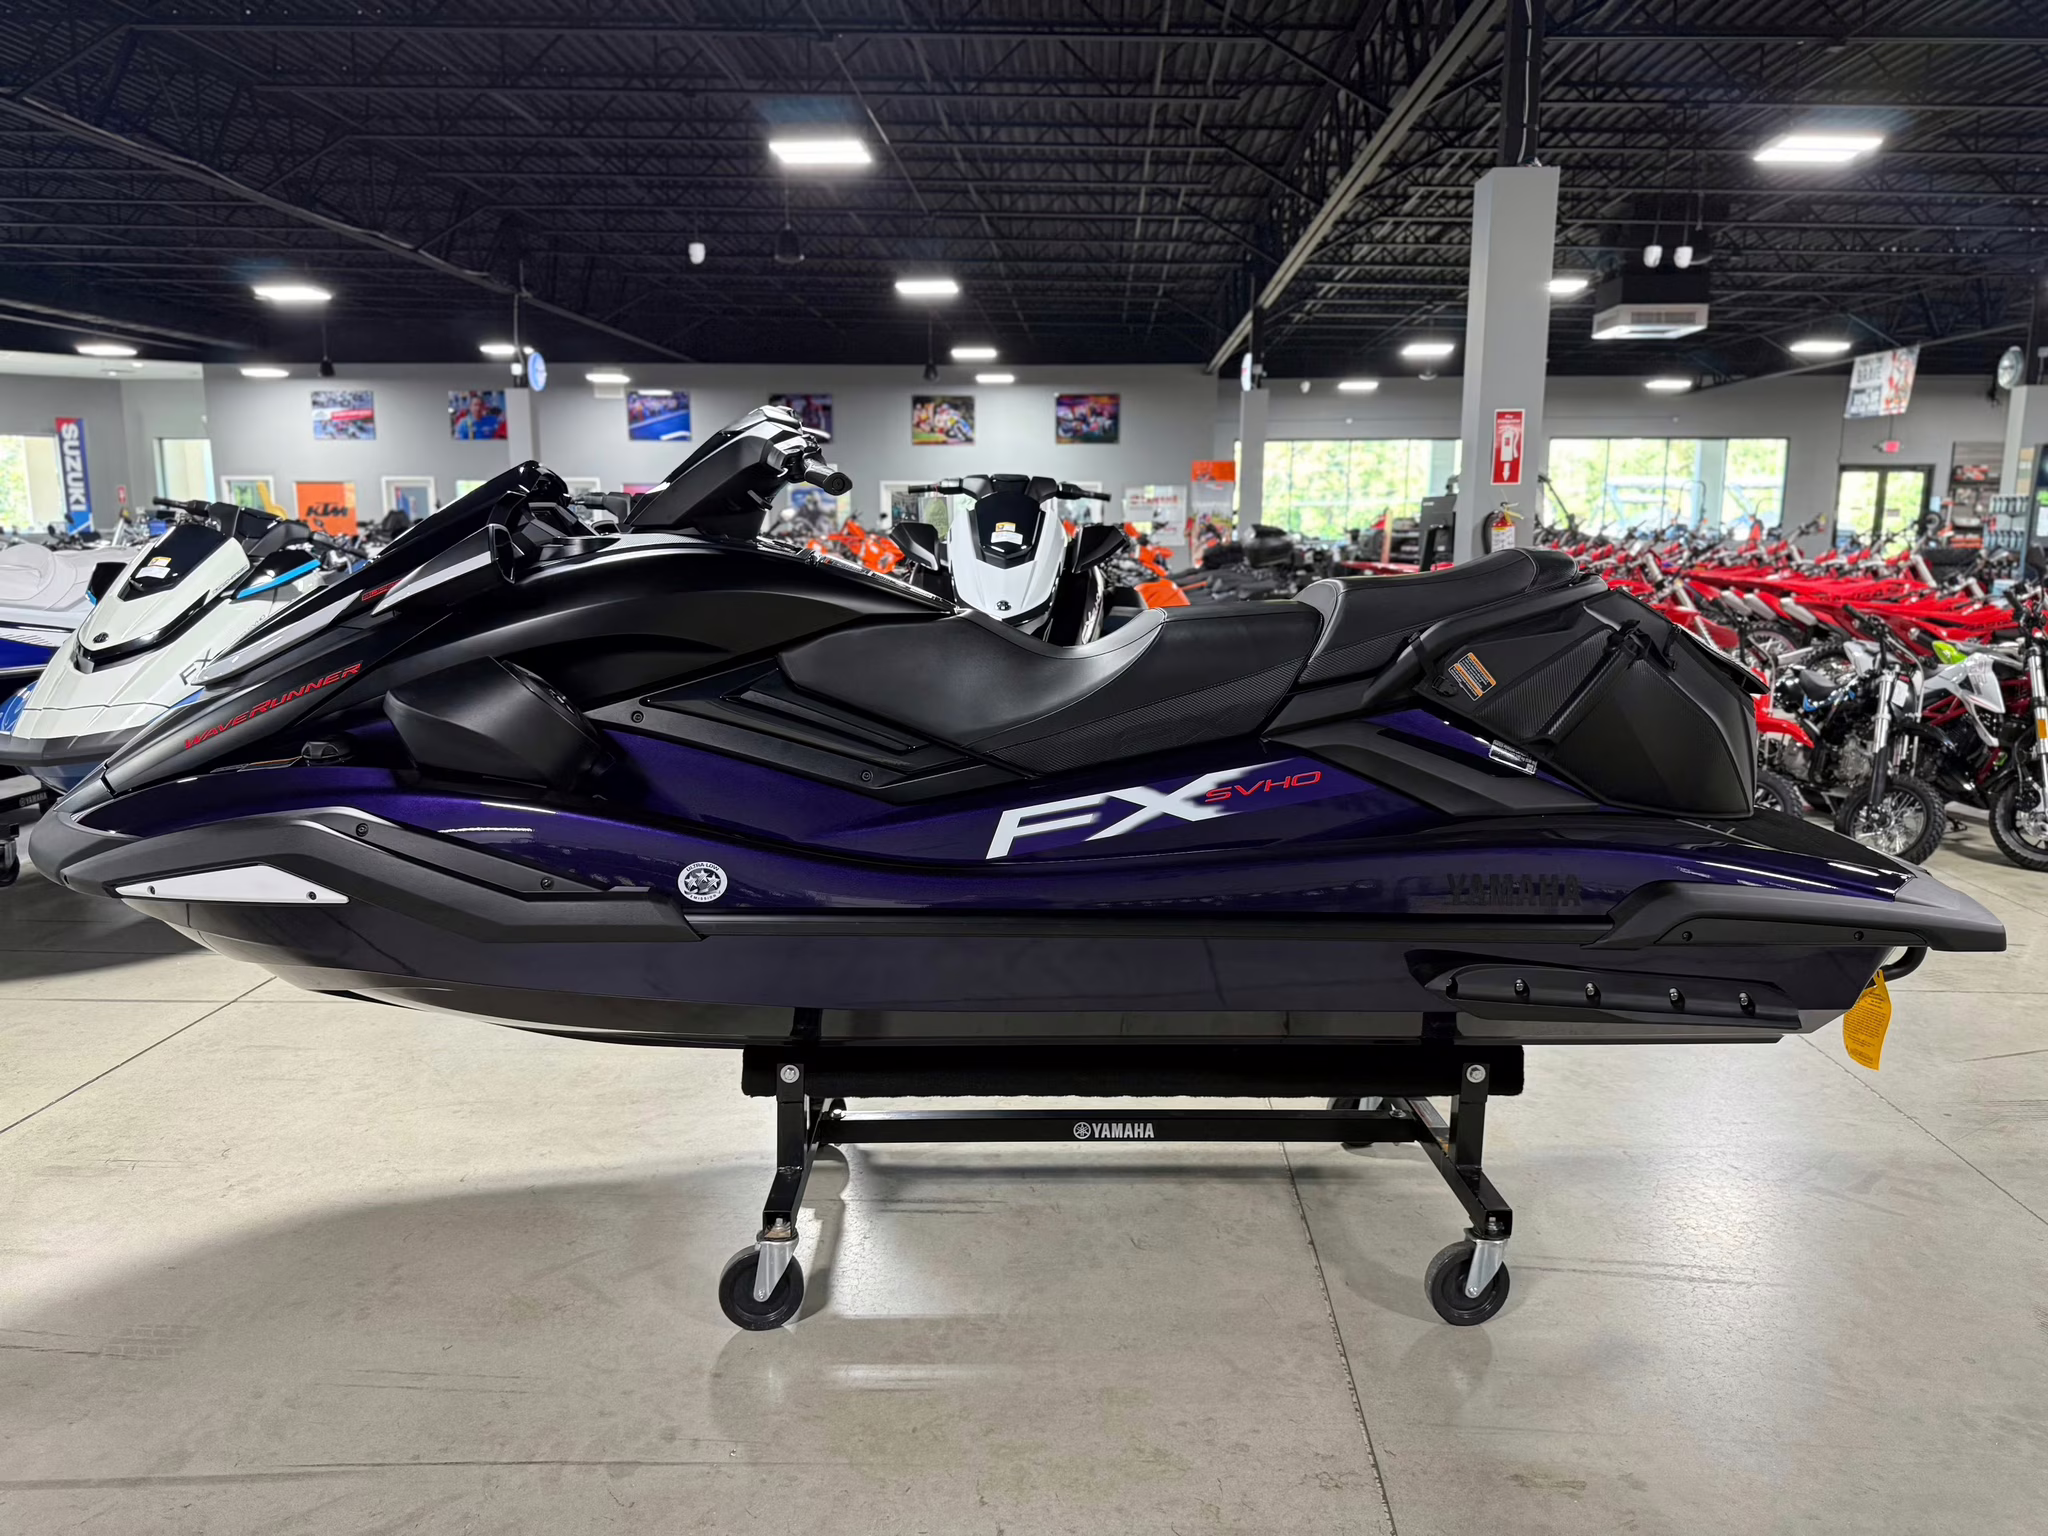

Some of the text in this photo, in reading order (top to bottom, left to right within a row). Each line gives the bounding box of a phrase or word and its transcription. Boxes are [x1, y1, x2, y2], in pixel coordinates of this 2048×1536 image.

[61, 422, 87, 512] SUZUKI
[305, 502, 349, 518] KTM
[184, 662, 363, 750] WAVERUNNER
[985, 758, 1322, 860] FX SVHO
[686, 862, 720, 872] ULTRA LOW
[1446, 872, 1582, 907] YAMAHA
[1091, 1122, 1155, 1139] YAMAHA
